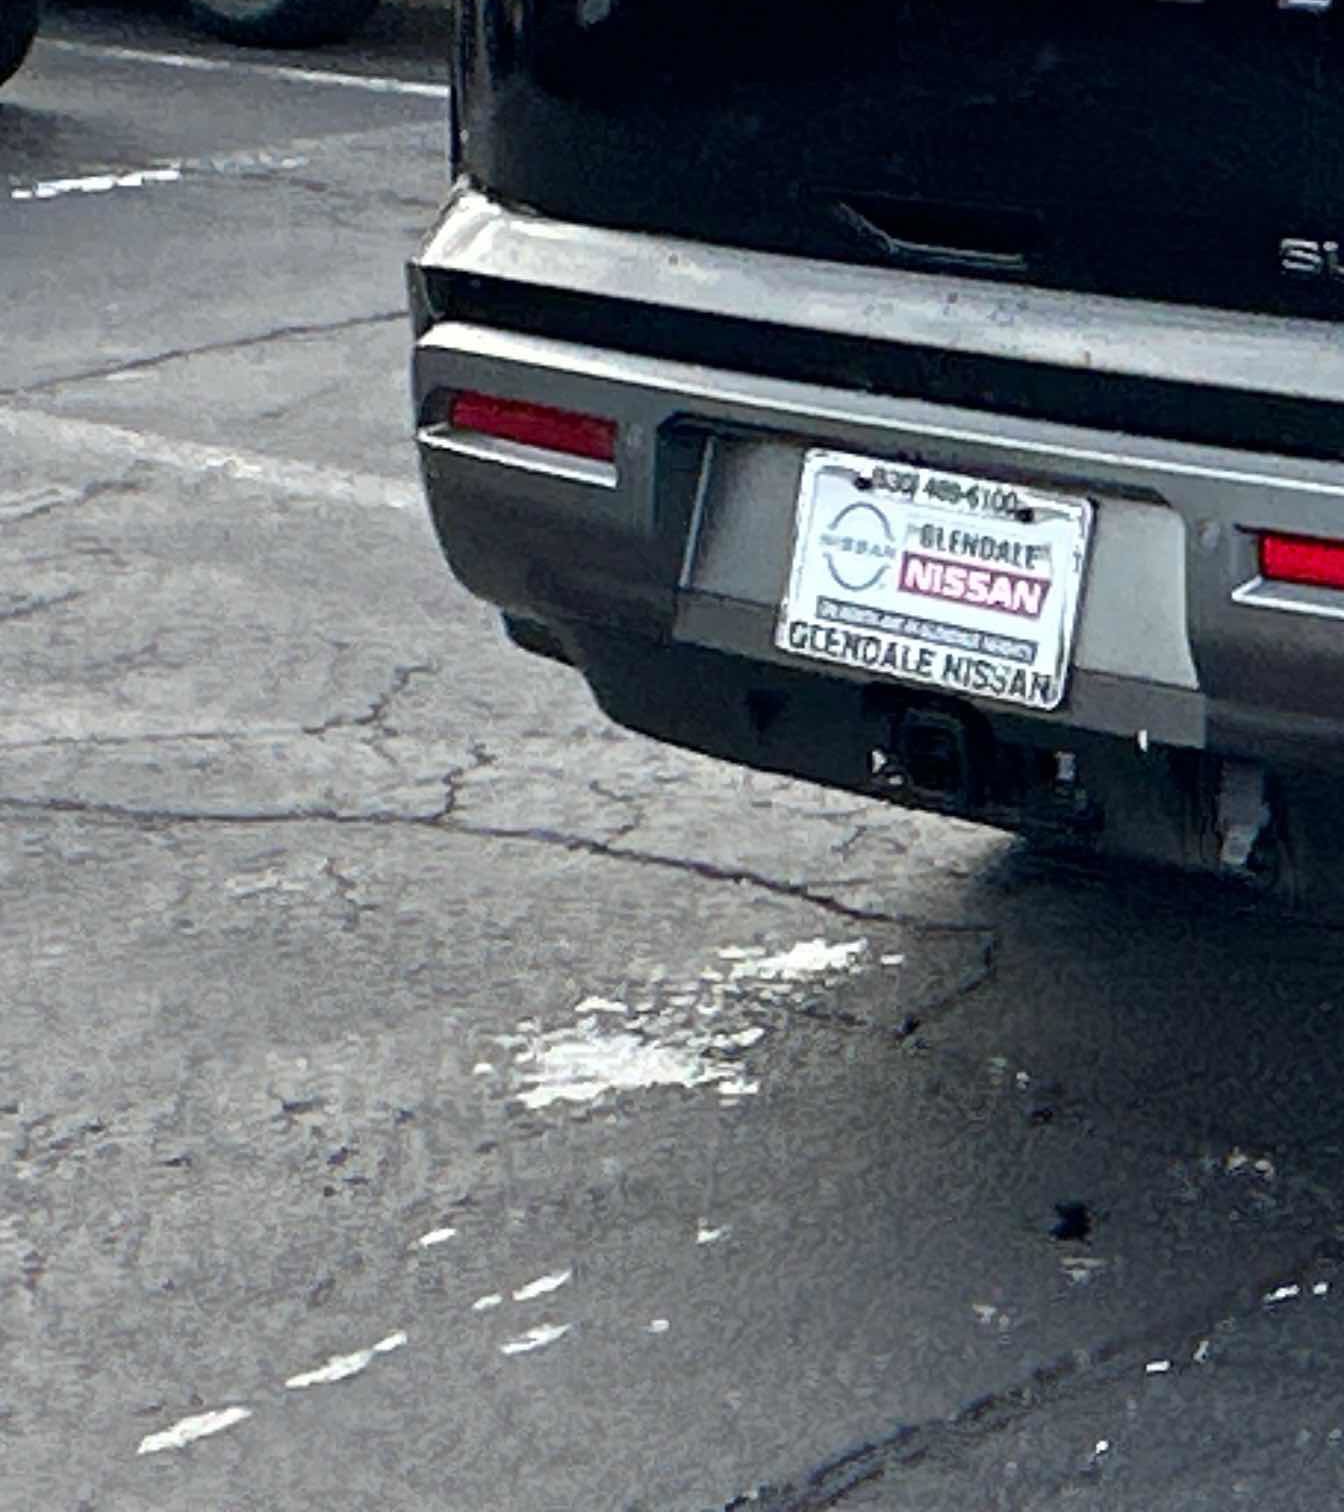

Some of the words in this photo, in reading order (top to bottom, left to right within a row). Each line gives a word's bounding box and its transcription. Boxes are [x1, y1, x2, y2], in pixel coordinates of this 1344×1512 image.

[919, 523, 1038, 569] GLENDALE
[904, 558, 1042, 614] NISSAN
[789, 620, 936, 678] GLENDALE
[941, 654, 1054, 705] NISSAN
